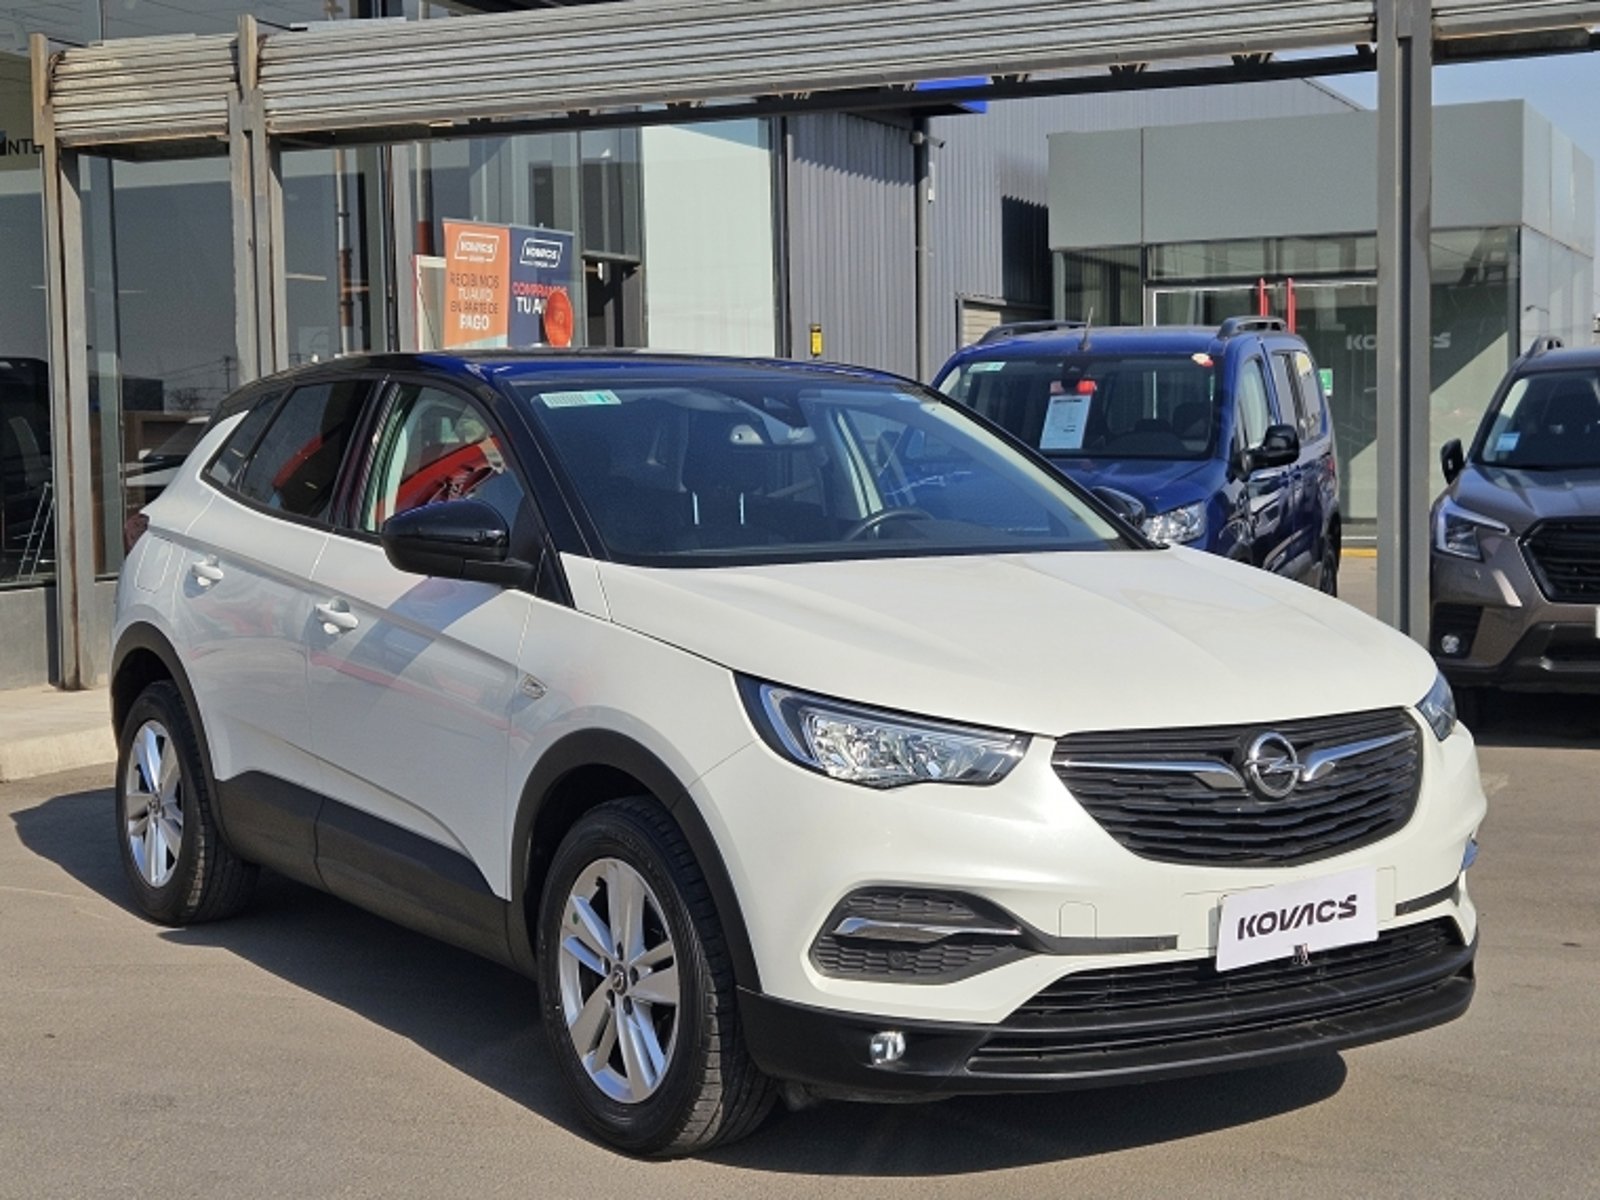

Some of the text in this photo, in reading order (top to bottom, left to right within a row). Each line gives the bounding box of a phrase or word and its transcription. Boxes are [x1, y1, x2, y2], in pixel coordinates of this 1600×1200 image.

[515, 296, 531, 314] TU
[459, 313, 490, 330] PAGO
[1345, 332, 1451, 350] KOS
[1237, 894, 1357, 940] KOVACS
